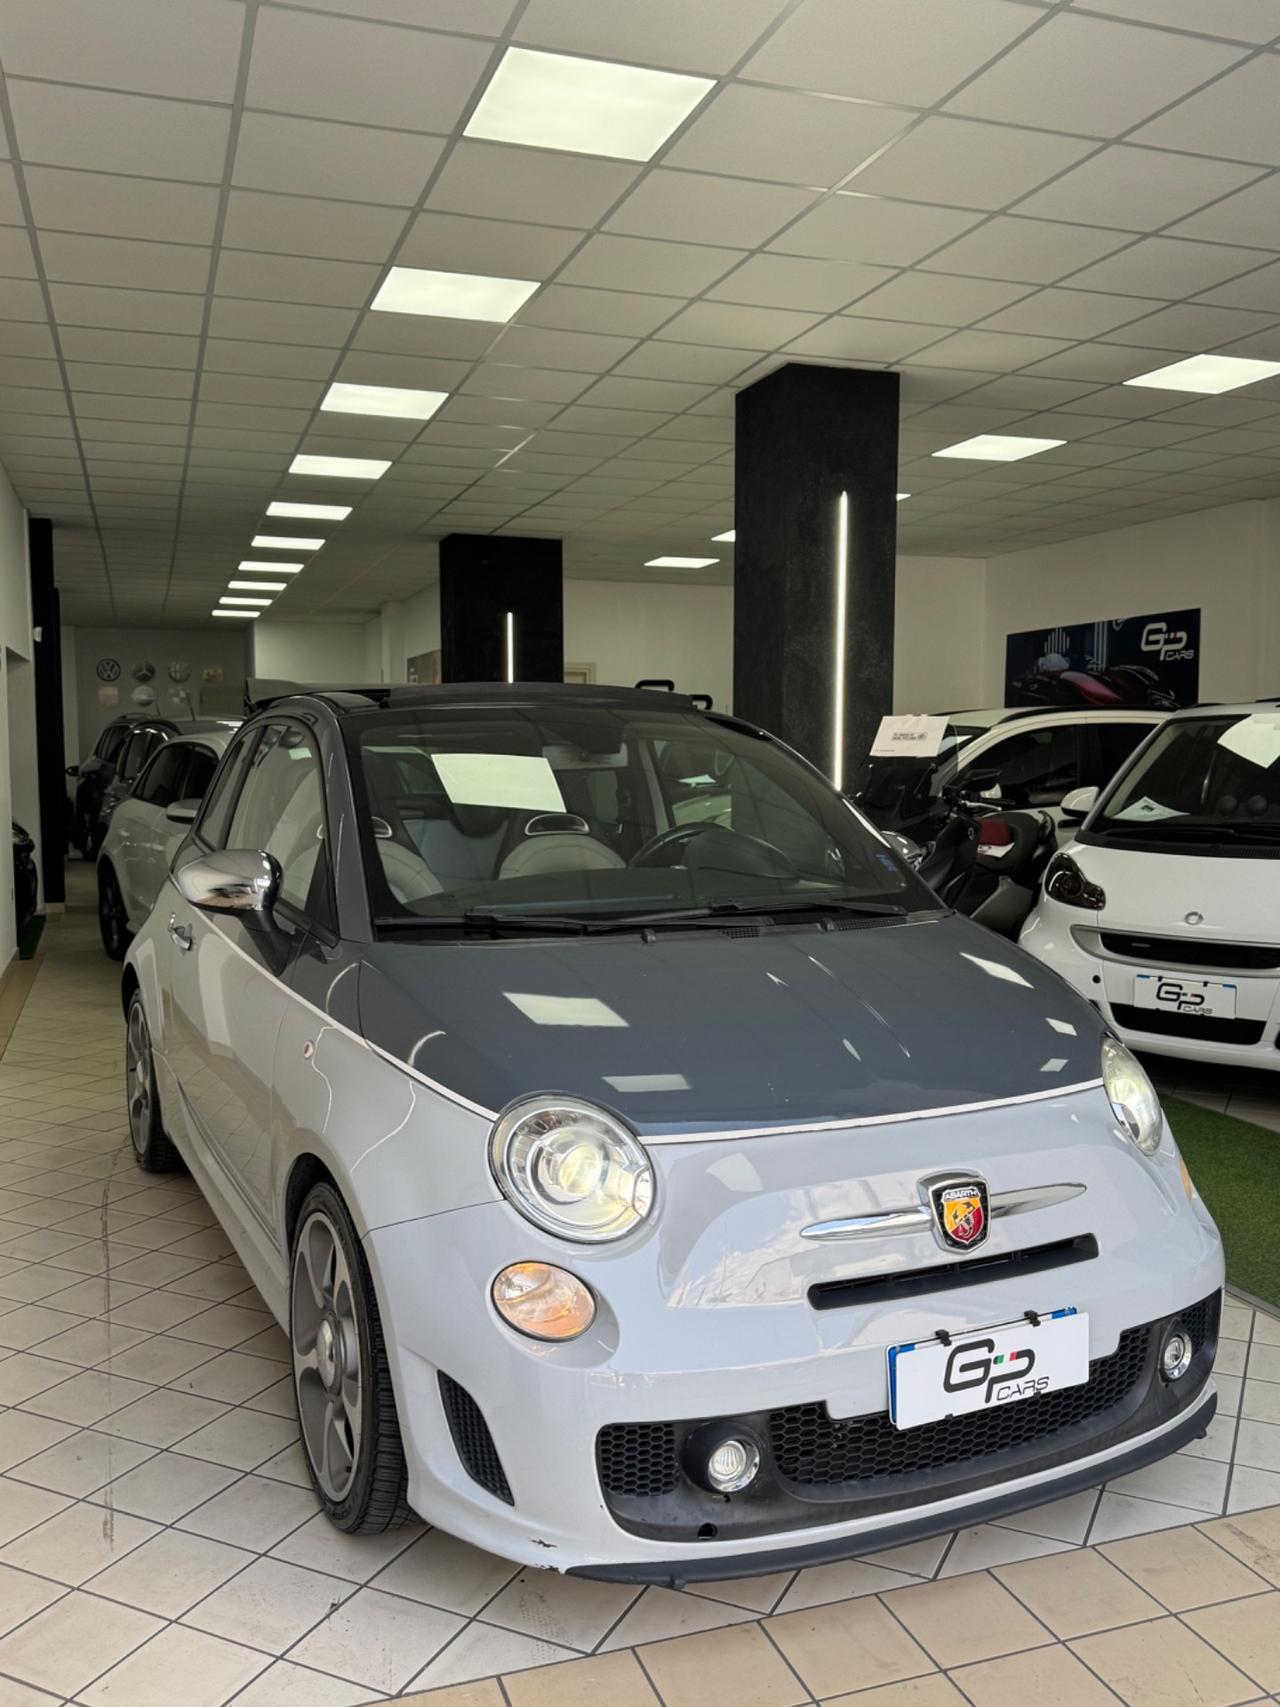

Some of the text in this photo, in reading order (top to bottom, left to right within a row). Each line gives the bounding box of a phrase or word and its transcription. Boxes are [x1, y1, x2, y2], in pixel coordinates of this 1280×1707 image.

[1141, 622, 1187, 661] GP
[1166, 649, 1194, 660] CARS
[1156, 983, 1205, 1010] GP
[944, 1188, 979, 1199] ABARTH
[944, 1338, 1035, 1403] GP
[996, 1376, 1049, 1401] CARS
